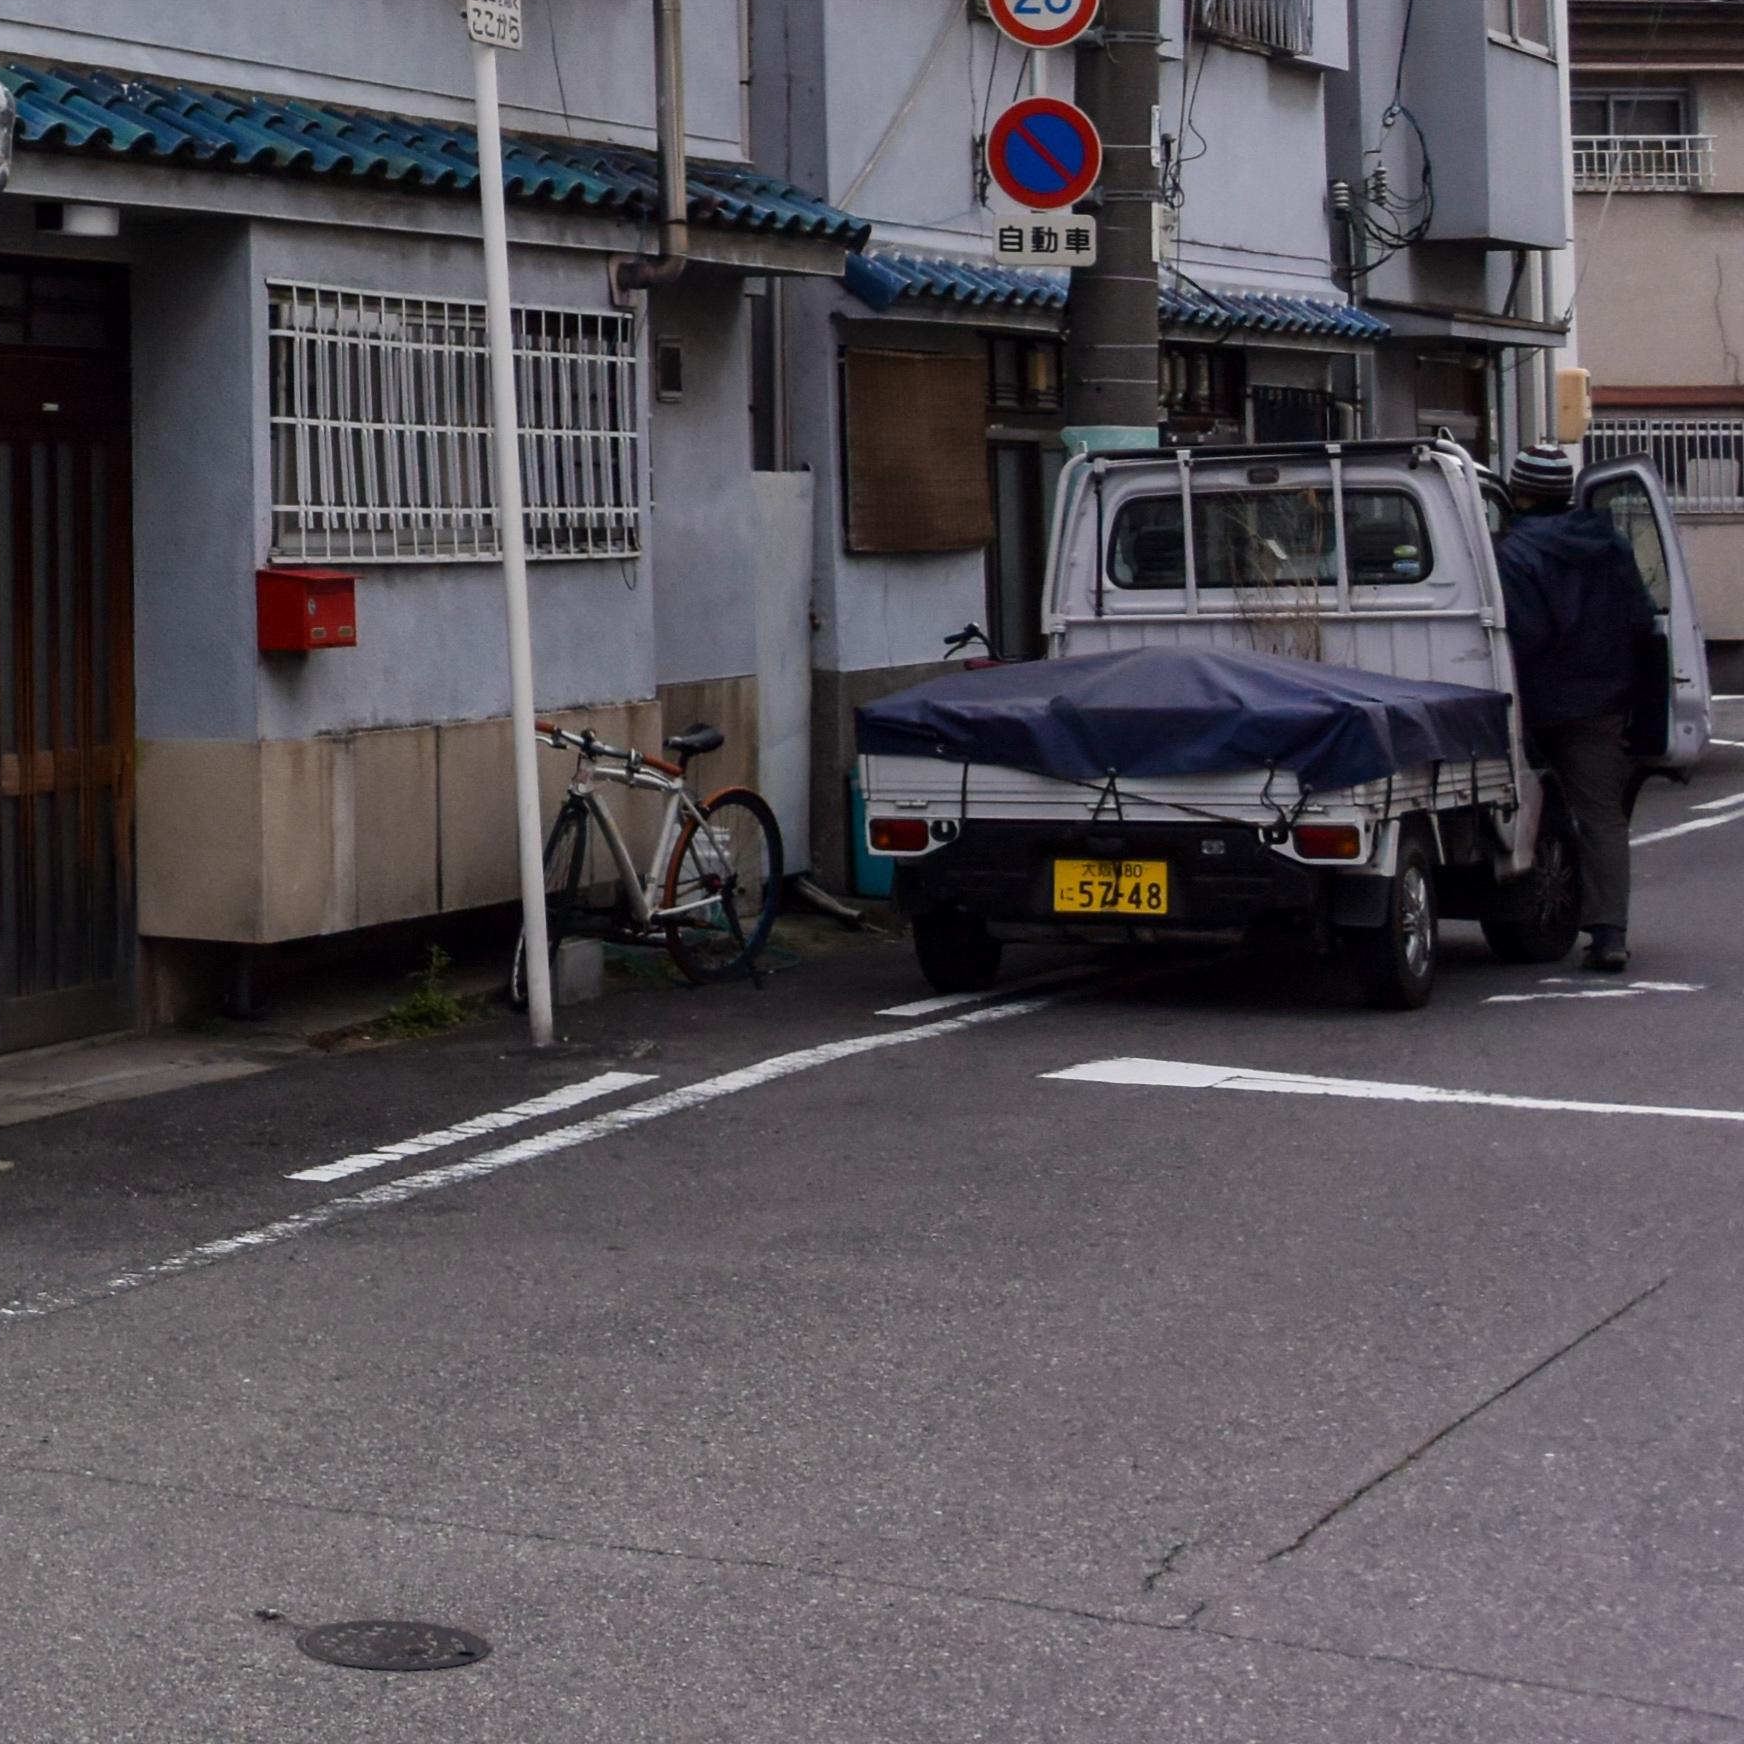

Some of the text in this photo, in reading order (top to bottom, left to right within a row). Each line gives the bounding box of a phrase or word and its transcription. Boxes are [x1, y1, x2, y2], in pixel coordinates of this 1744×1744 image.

[472, 7, 520, 43] ここから
[998, 225, 1091, 255] 自動車
[1060, 887, 1074, 901] に
